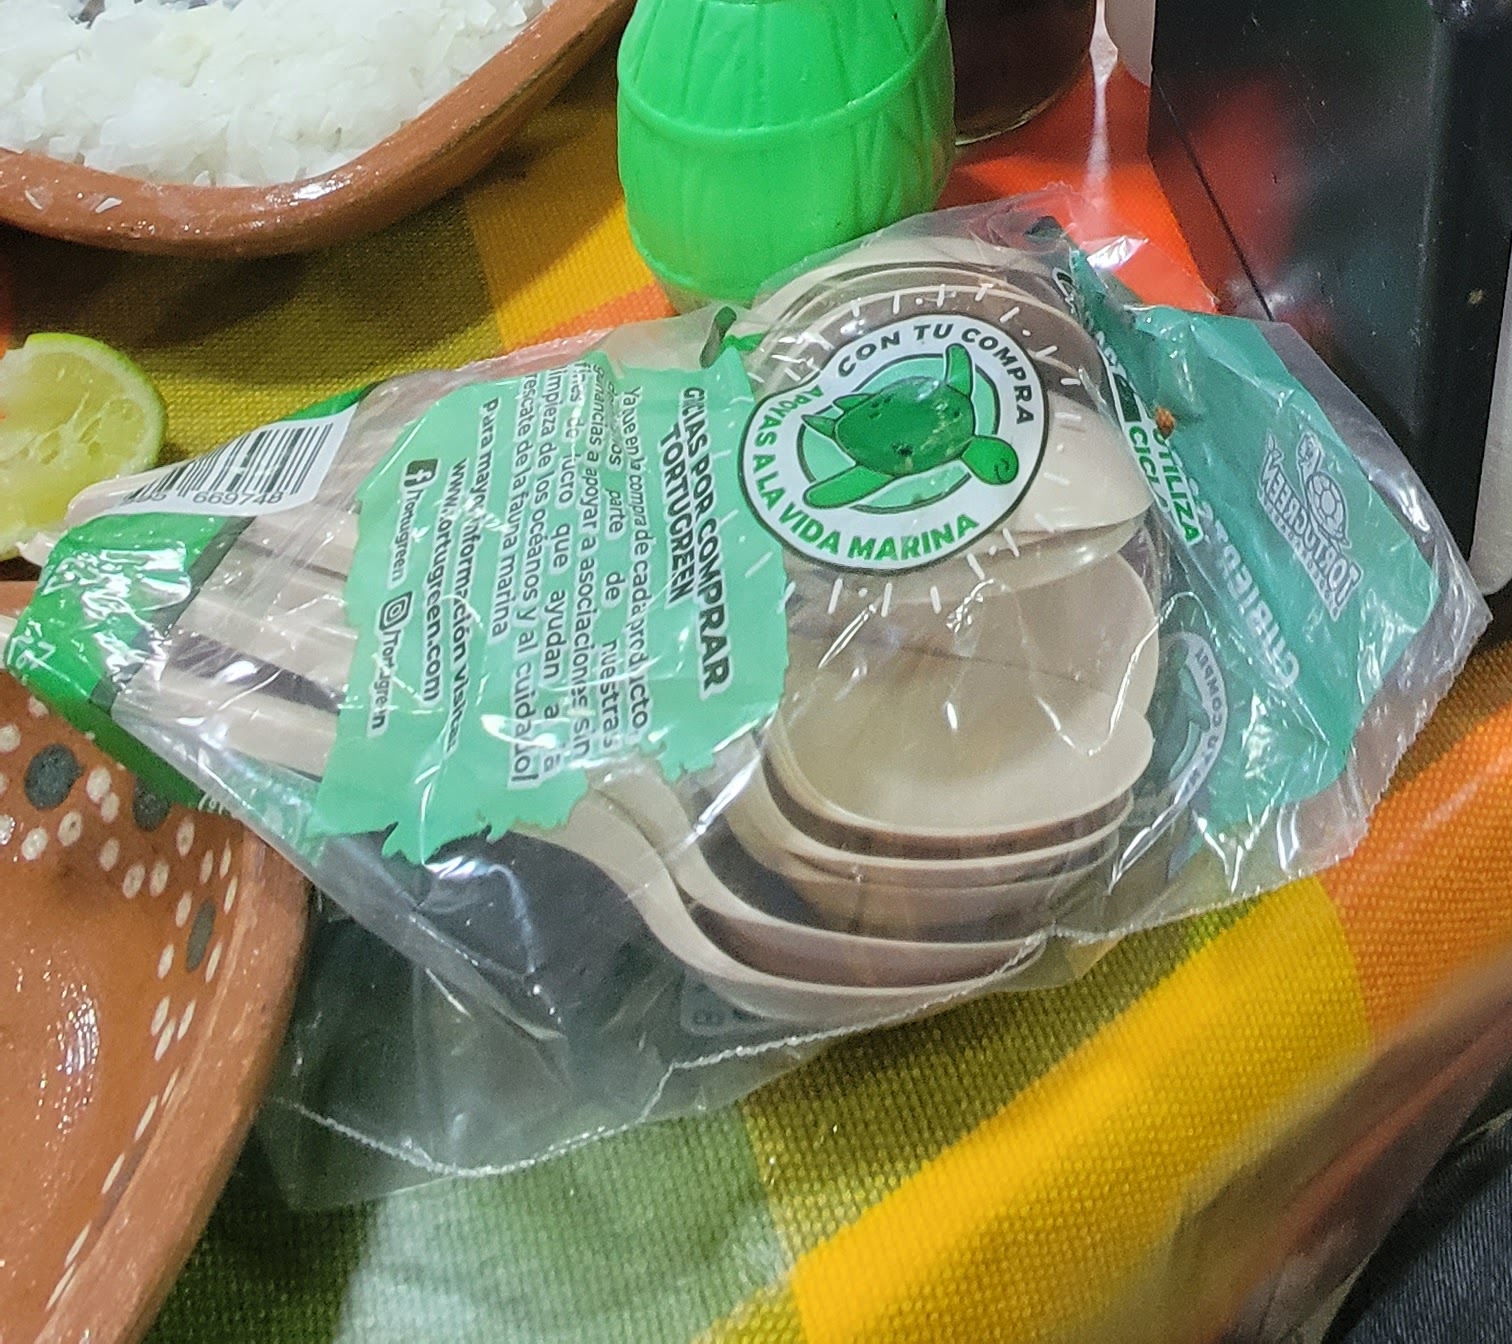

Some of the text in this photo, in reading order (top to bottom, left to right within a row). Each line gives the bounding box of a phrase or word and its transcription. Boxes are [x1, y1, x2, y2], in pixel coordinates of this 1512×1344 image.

[838, 323, 1034, 424] CON TU COMPRA
[482, 397, 498, 448] Para
[539, 368, 564, 436] limpieza
[537, 442, 555, 467] de
[586, 450, 598, 461] a
[625, 436, 638, 454] en
[533, 470, 554, 504] los
[752, 384, 980, 561] APOYAS A LA VIDA MARINA
[192, 491, 283, 506] 669748
[492, 374, 537, 637] rescate de la fauna marina
[580, 467, 598, 528] apoyar
[605, 488, 625, 532] parte
[627, 474, 646, 525] compra
[660, 423, 694, 603] TORTUGREEN
[523, 509, 547, 601] océanos
[550, 524, 570, 567] que
[581, 538, 595, 550] a
[633, 529, 653, 555] de
[681, 387, 729, 691] GCIAS POR COMPRAR
[422, 459, 466, 701] www.ortugreen.com
[604, 571, 625, 600] de
[631, 560, 652, 615] cada
[516, 607, 537, 621] y
[543, 590, 566, 678] ayudan
[571, 557, 597, 707] asociaciones
[517, 631, 537, 653] al
[543, 704, 559, 719] a
[572, 718, 595, 757] sin
